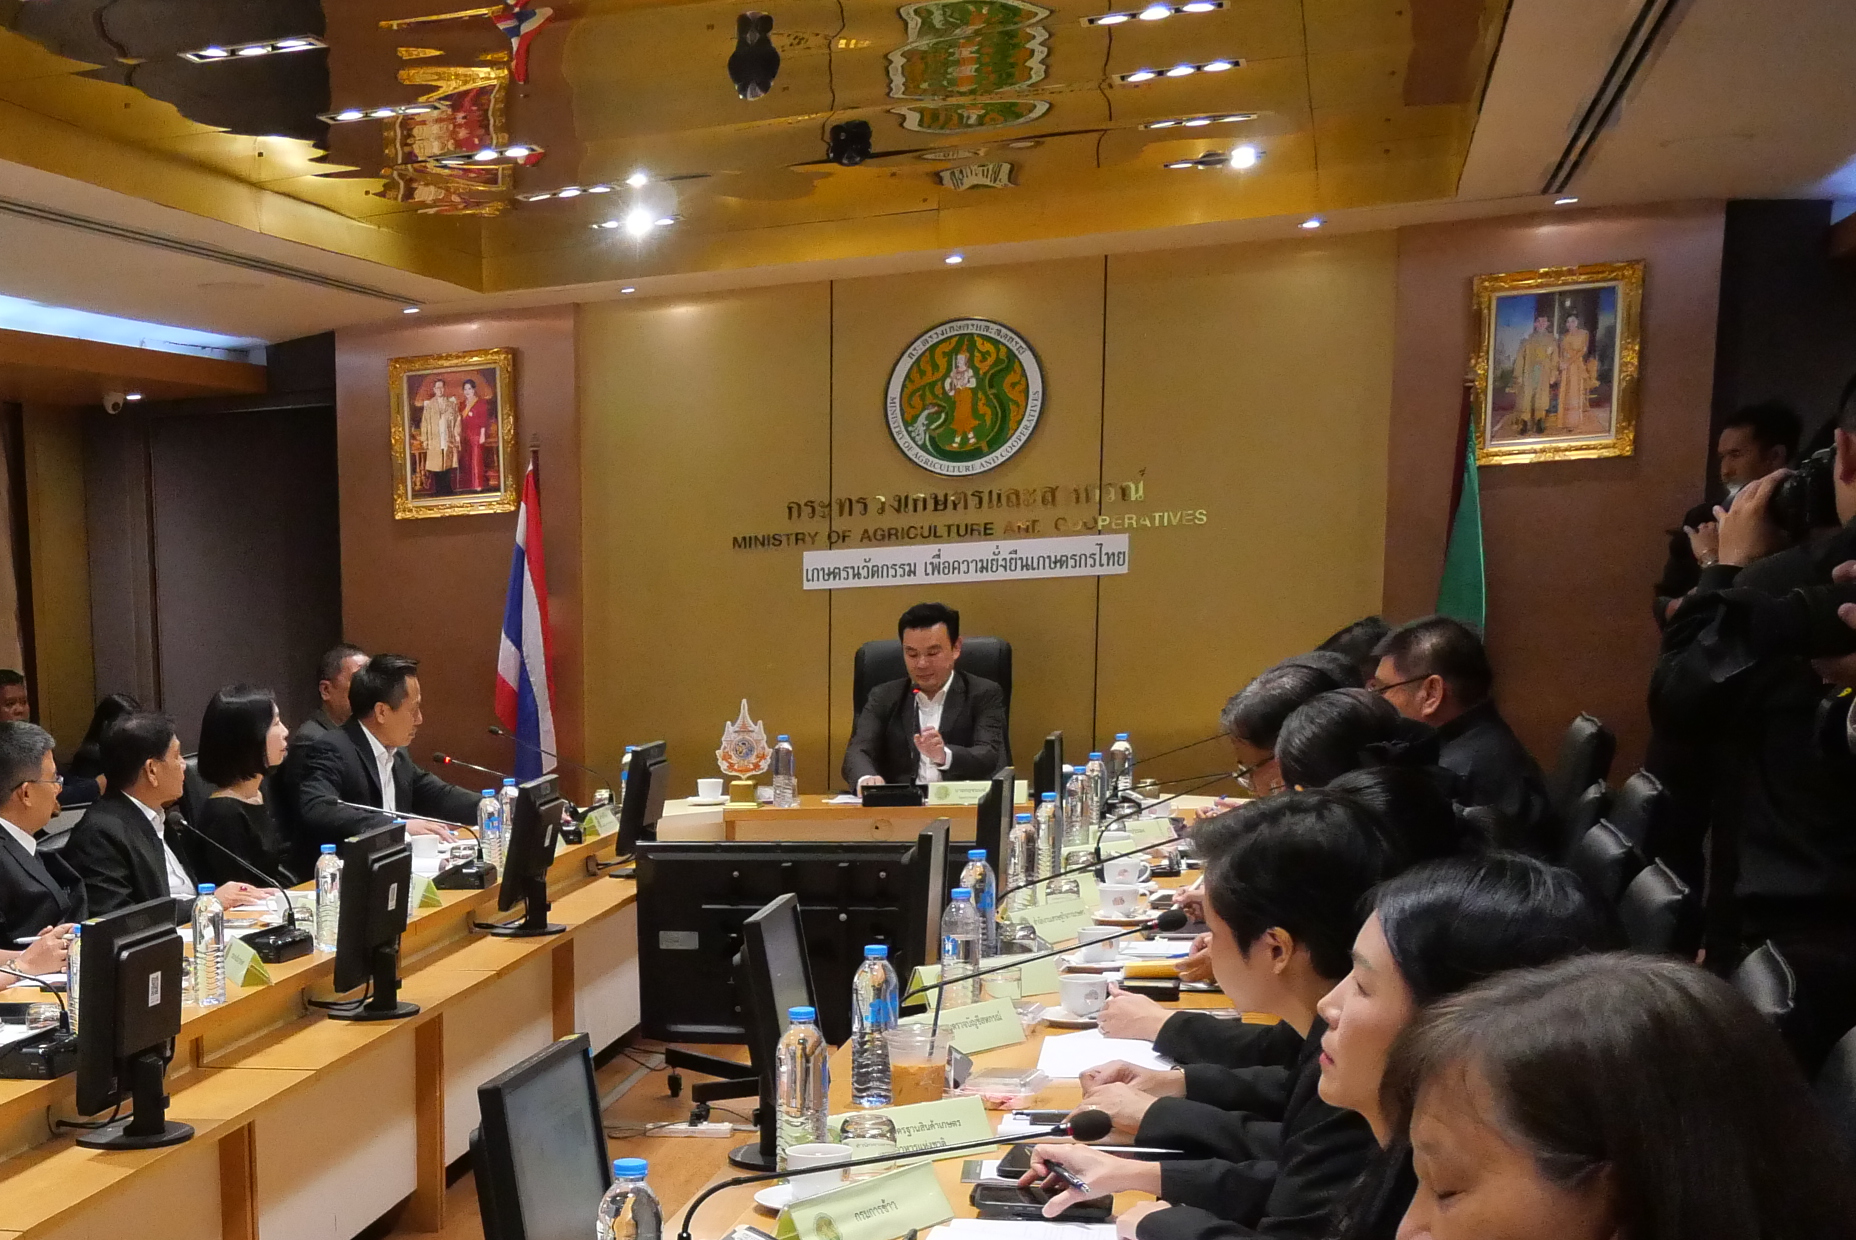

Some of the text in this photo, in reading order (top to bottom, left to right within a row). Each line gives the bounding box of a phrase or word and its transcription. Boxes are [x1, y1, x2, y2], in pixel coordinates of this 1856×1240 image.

[889, 396, 906, 441] MINISTRY
[912, 451, 977, 474] AGRICULTURE
[978, 454, 999, 471] AND
[999, 390, 1040, 458] COOPERATIVES
[731, 531, 820, 550] MINISTRY
[827, 529, 852, 545] OF
[859, 521, 994, 543] AGRICULTURE
[805, 542, 1127, 583] เกษตรนวัตกรรม เพื่อความยั่งยืนเกษตรกรไทย
[896, 1118, 962, 1137] ตรฐานสินค้าเกษตร
